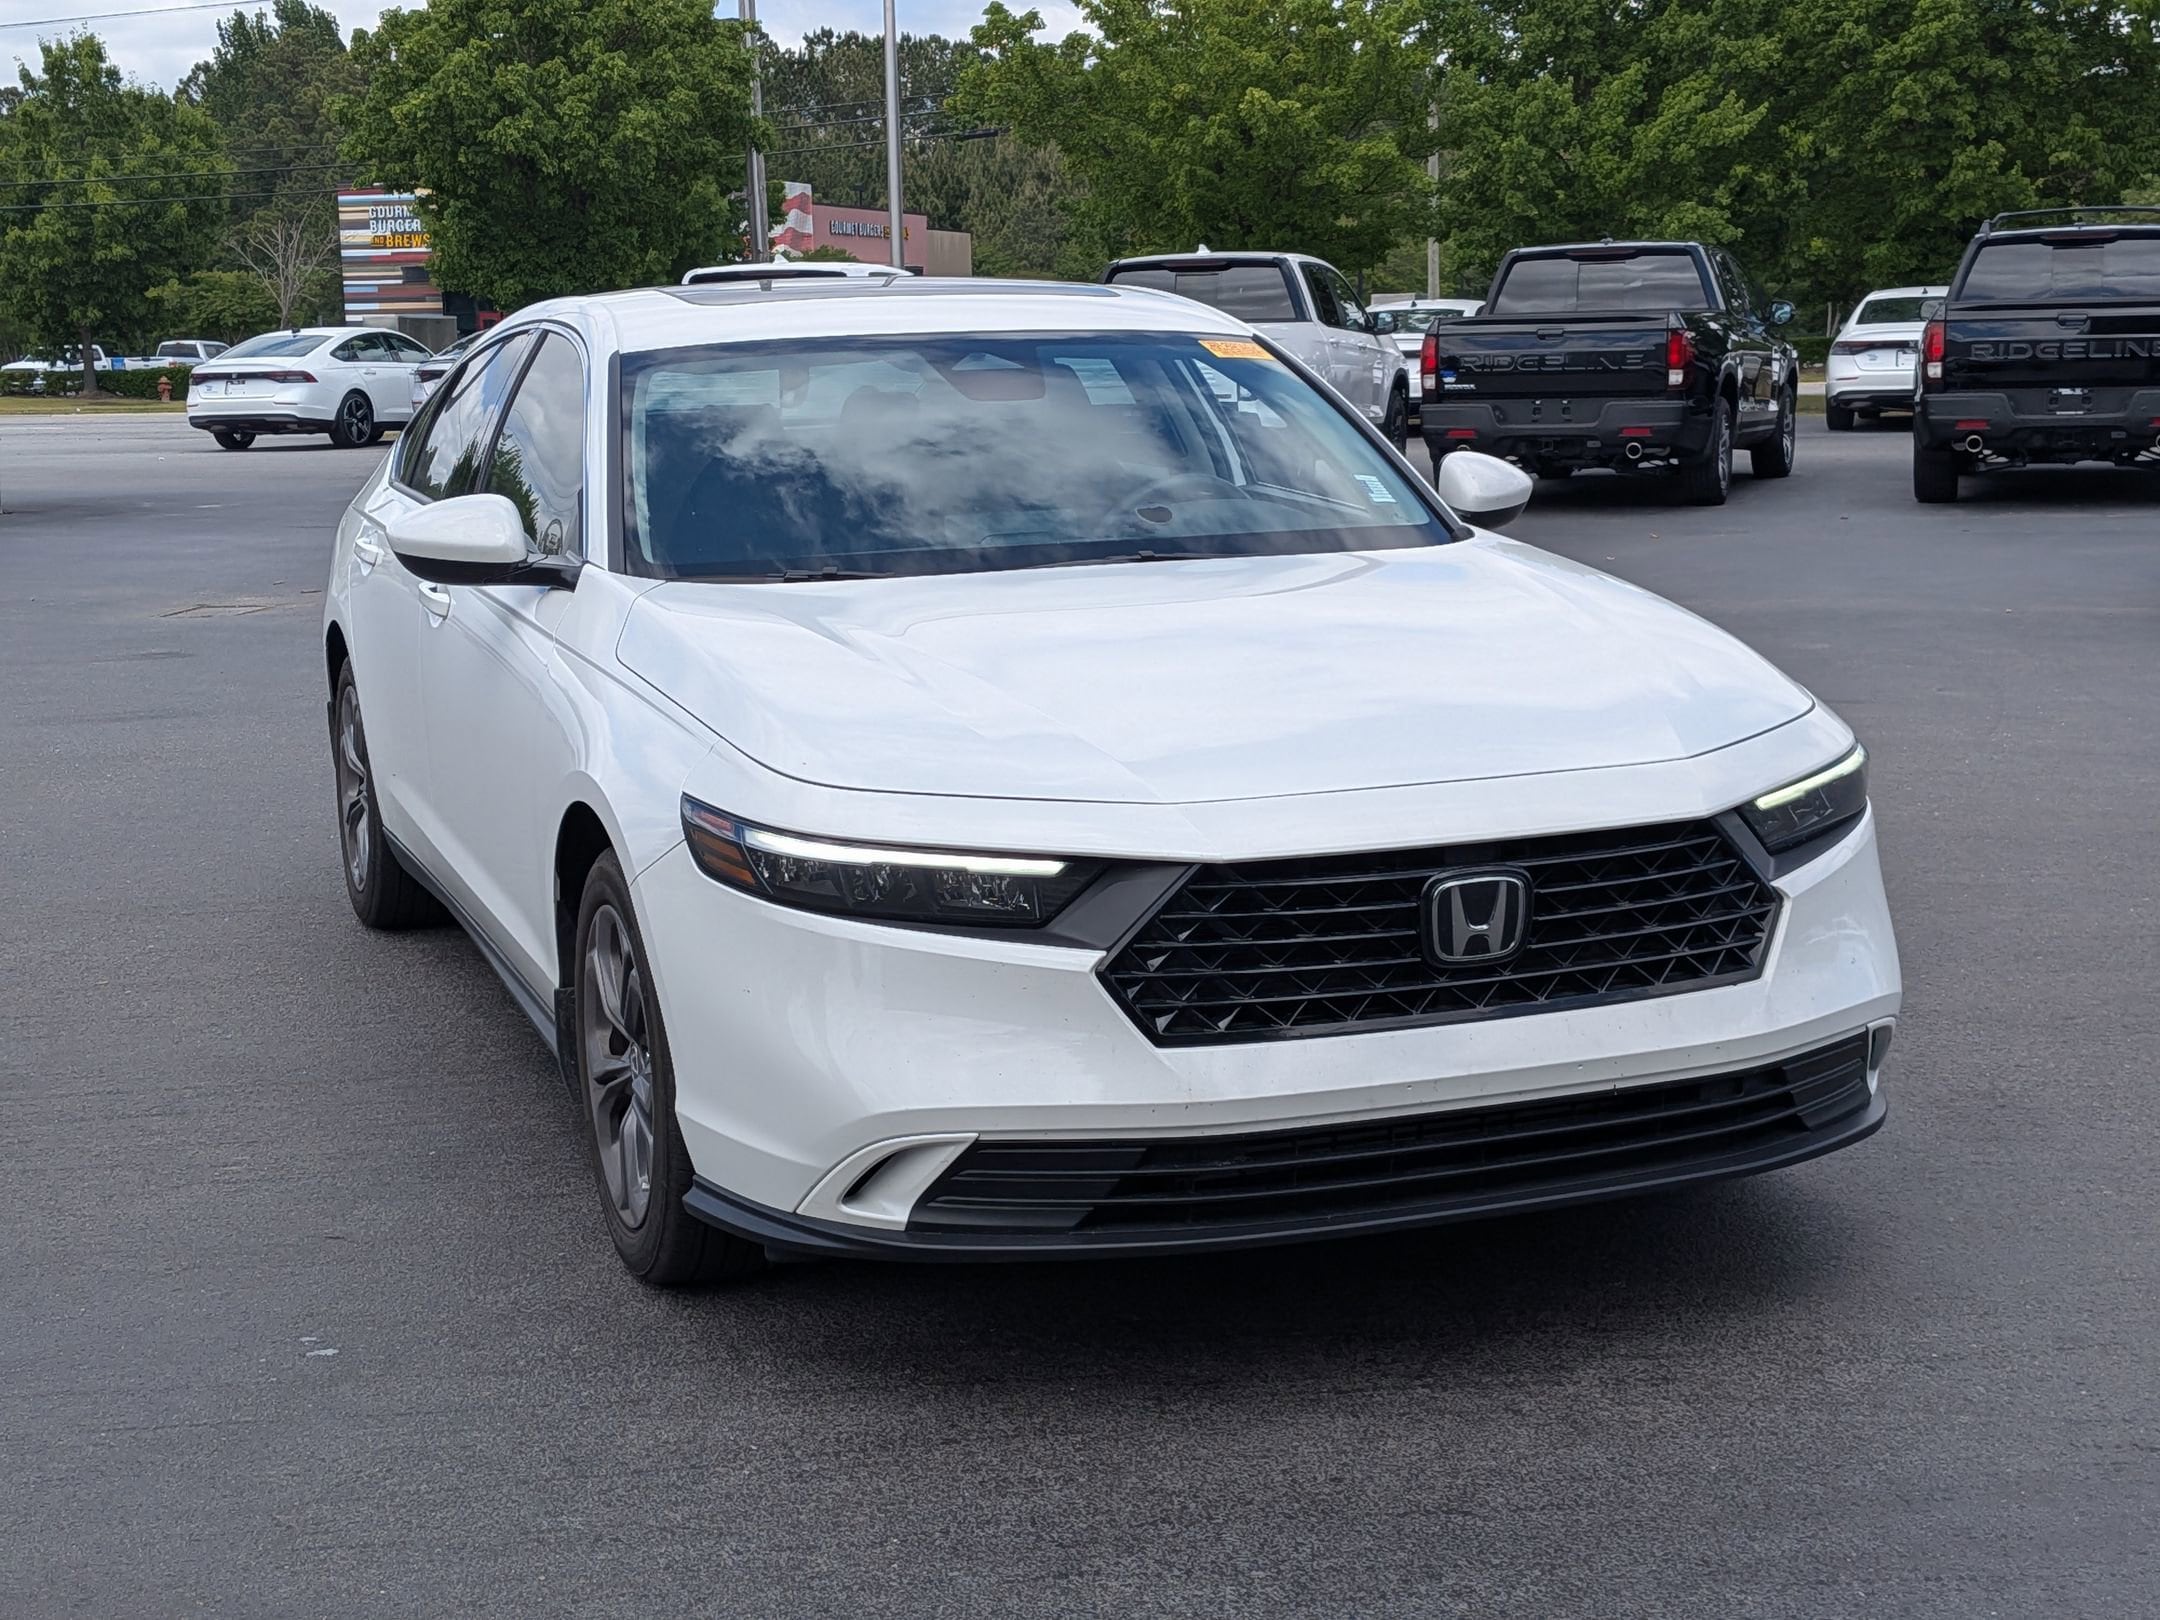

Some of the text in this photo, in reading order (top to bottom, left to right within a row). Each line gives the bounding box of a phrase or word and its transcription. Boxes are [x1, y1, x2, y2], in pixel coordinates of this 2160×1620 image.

[368, 204, 414, 219] GOURM
[386, 233, 431, 248] BREWS
[1459, 352, 1645, 372] RIDGELINE
